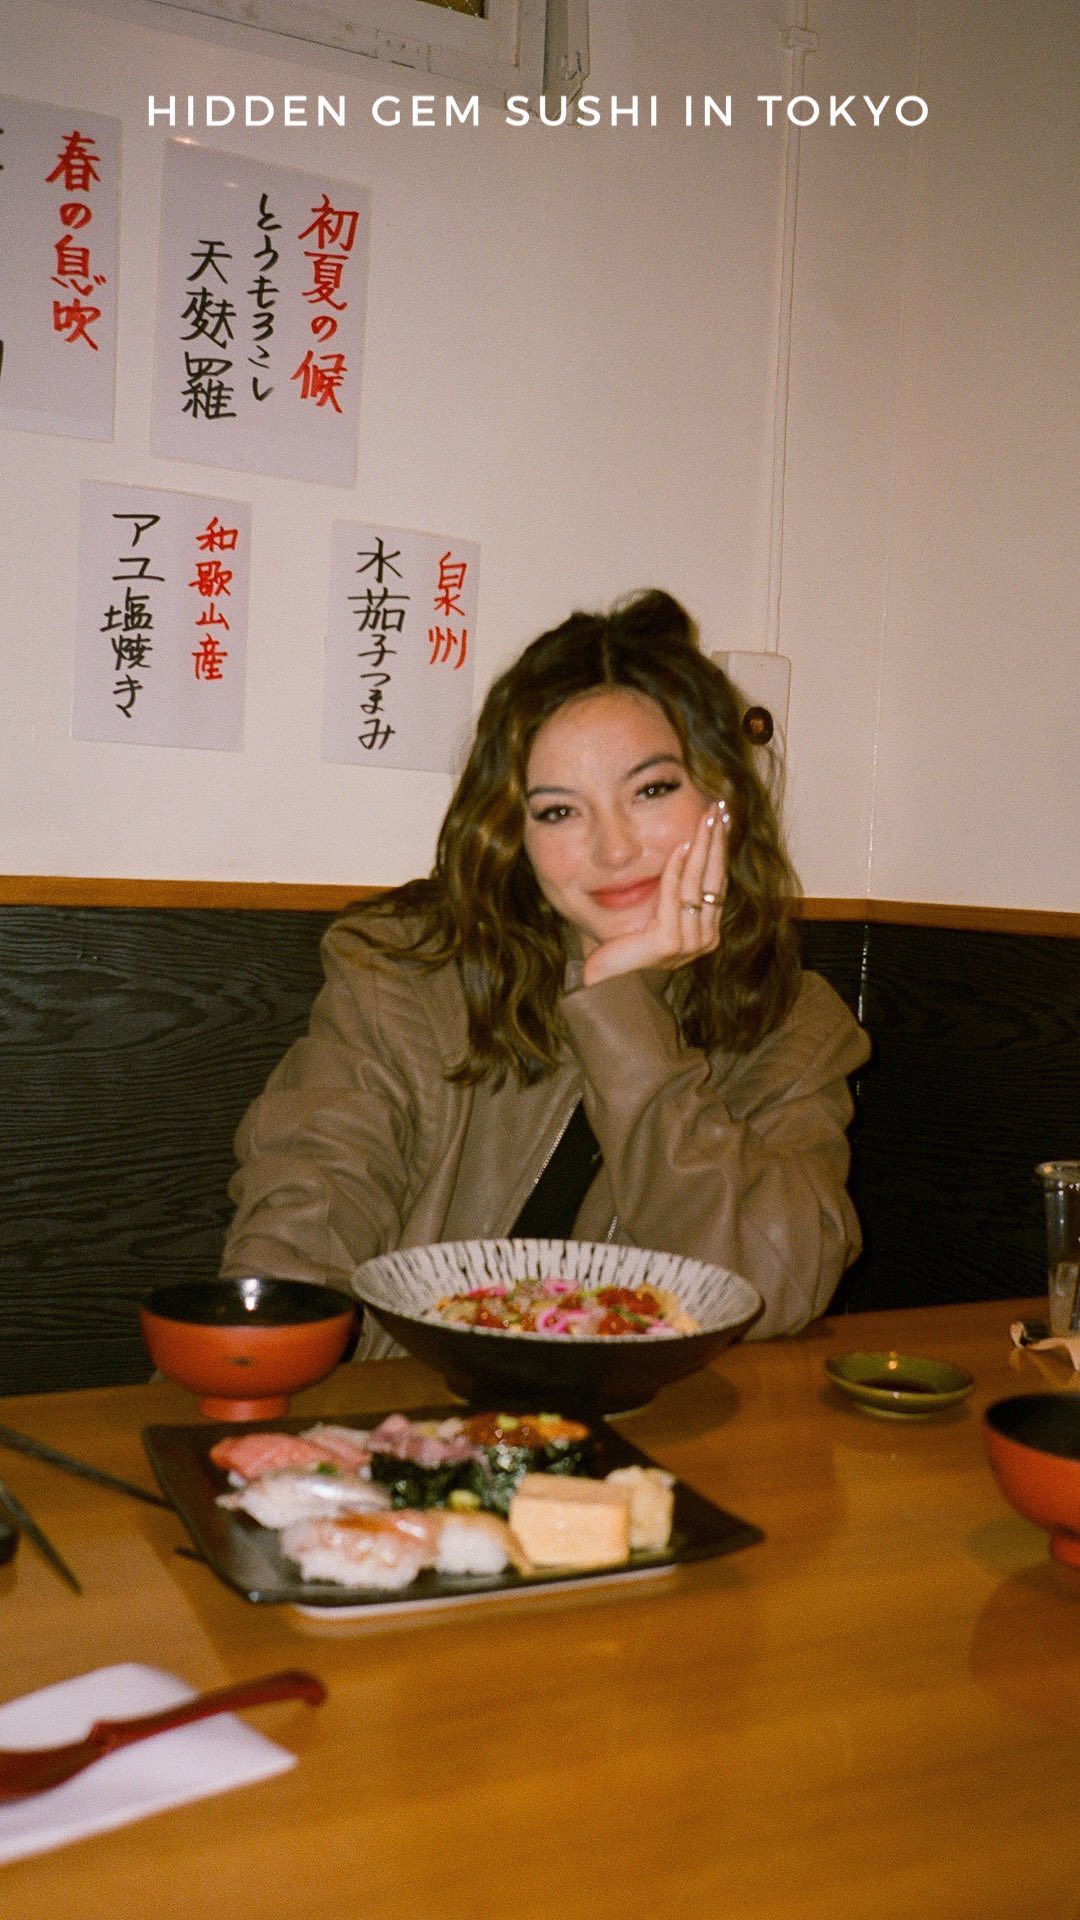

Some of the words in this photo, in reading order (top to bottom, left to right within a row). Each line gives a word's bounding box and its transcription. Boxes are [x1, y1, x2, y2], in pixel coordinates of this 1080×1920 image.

[45, 130, 107, 351] 春の息吹
[247, 193, 282, 401] とうもろこし
[291, 194, 360, 413] 初夏の候
[100, 513, 166, 719] アユ塩焼き
[189, 516, 239, 681] 和歌山産
[348, 537, 410, 750] 水茄子つまみ
[428, 552, 467, 668] 泉州
